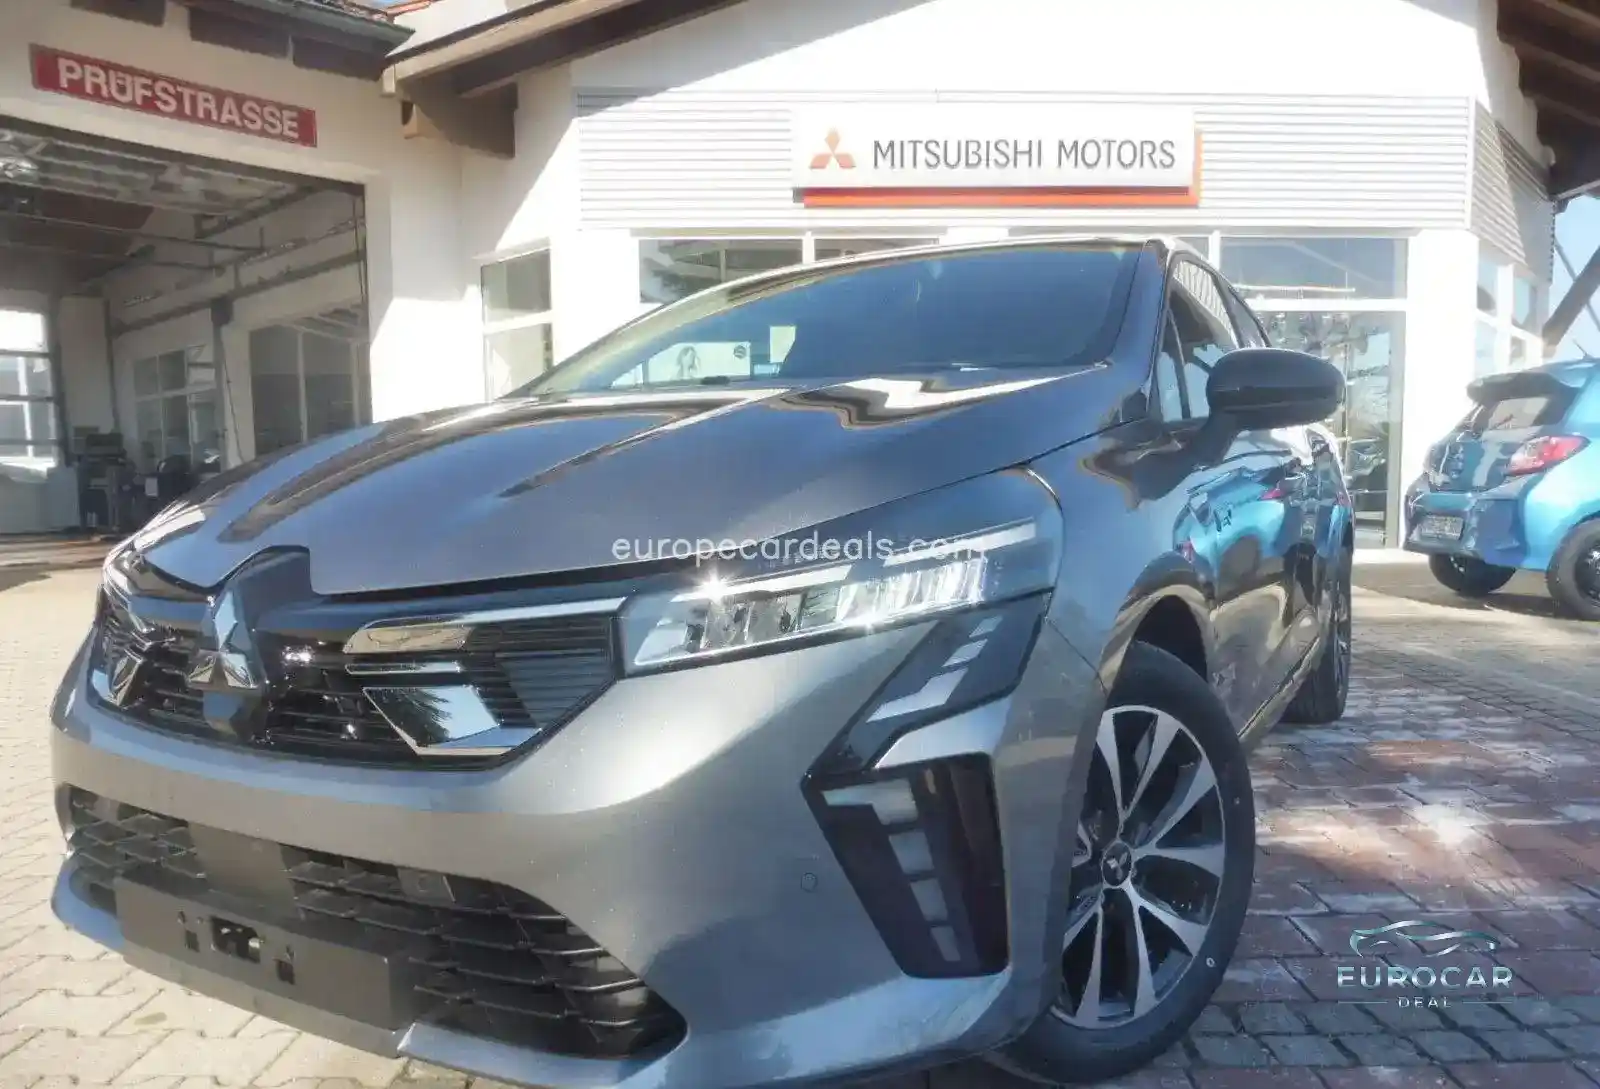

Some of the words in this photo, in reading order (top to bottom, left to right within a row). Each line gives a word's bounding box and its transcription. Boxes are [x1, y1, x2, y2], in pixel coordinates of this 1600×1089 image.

[58, 57, 300, 139] PRÜFSTRASSE
[873, 139, 1043, 169] MITSUBISHI
[1057, 139, 1176, 169] MOTORS
